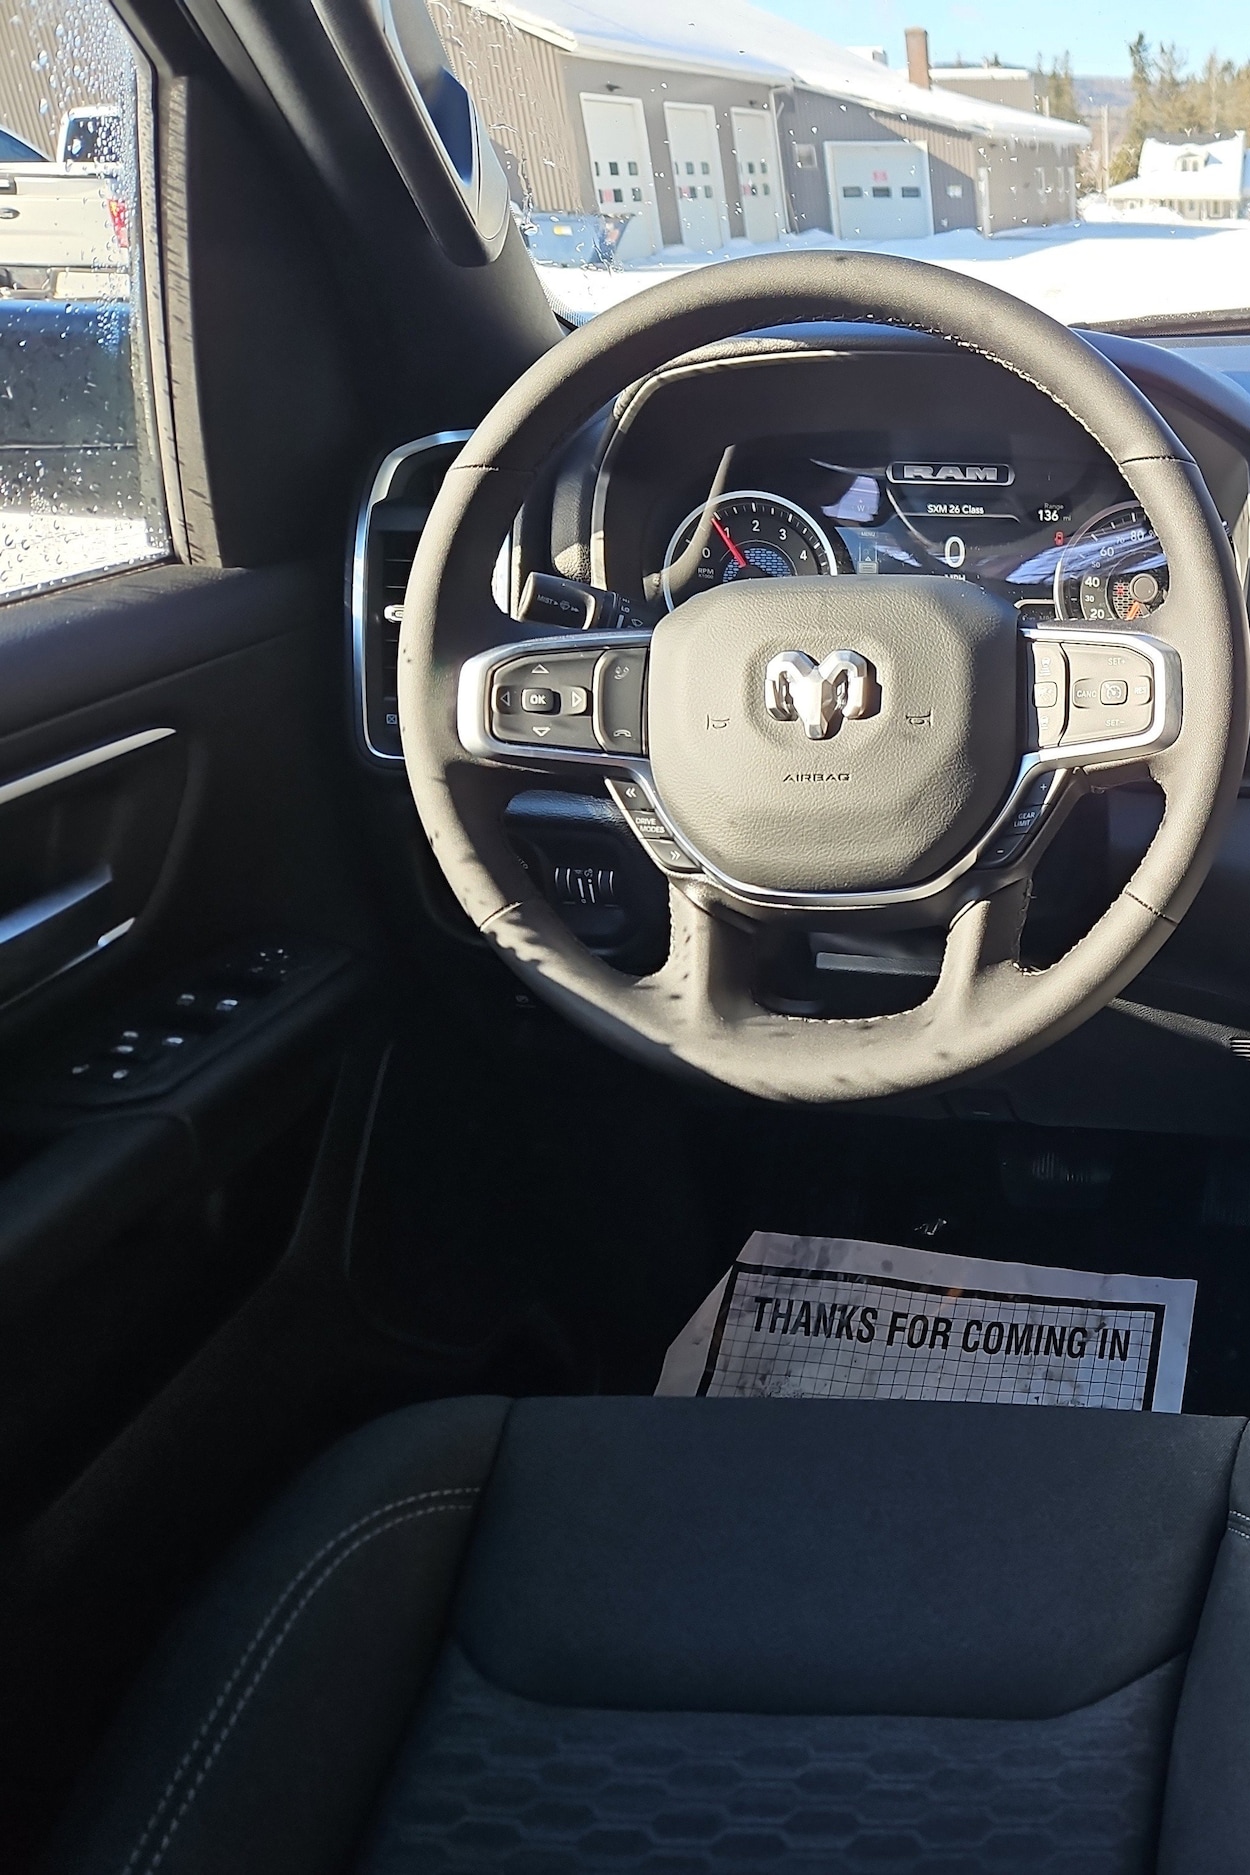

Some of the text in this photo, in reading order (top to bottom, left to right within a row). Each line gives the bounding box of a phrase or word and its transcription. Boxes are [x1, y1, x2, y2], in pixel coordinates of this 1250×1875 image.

[903, 465, 998, 481] RAM
[927, 504, 985, 515] SXM 26 Class
[1044, 503, 1064, 511] Range
[1038, 509, 1059, 521] 136
[752, 520, 760, 532] 2
[779, 528, 787, 540] 3
[1130, 530, 1144, 542] 80
[702, 547, 711, 559] 0
[799, 550, 808, 561] 4
[944, 535, 966, 569] 0
[1100, 547, 1114, 557] 60
[698, 567, 714, 575] RPM
[1084, 576, 1100, 588] 40
[1084, 595, 1095, 603] 30
[1090, 608, 1104, 620] 20
[529, 694, 547, 705] OK
[782, 773, 851, 783] AIRBAG
[1018, 811, 1036, 819] GEAR
[635, 817, 657, 826] DRIVE
[1014, 819, 1031, 827] LIMIT
[639, 824, 666, 834] MODES
[752, 1295, 1131, 1362] THANKS FOR COMING IN
